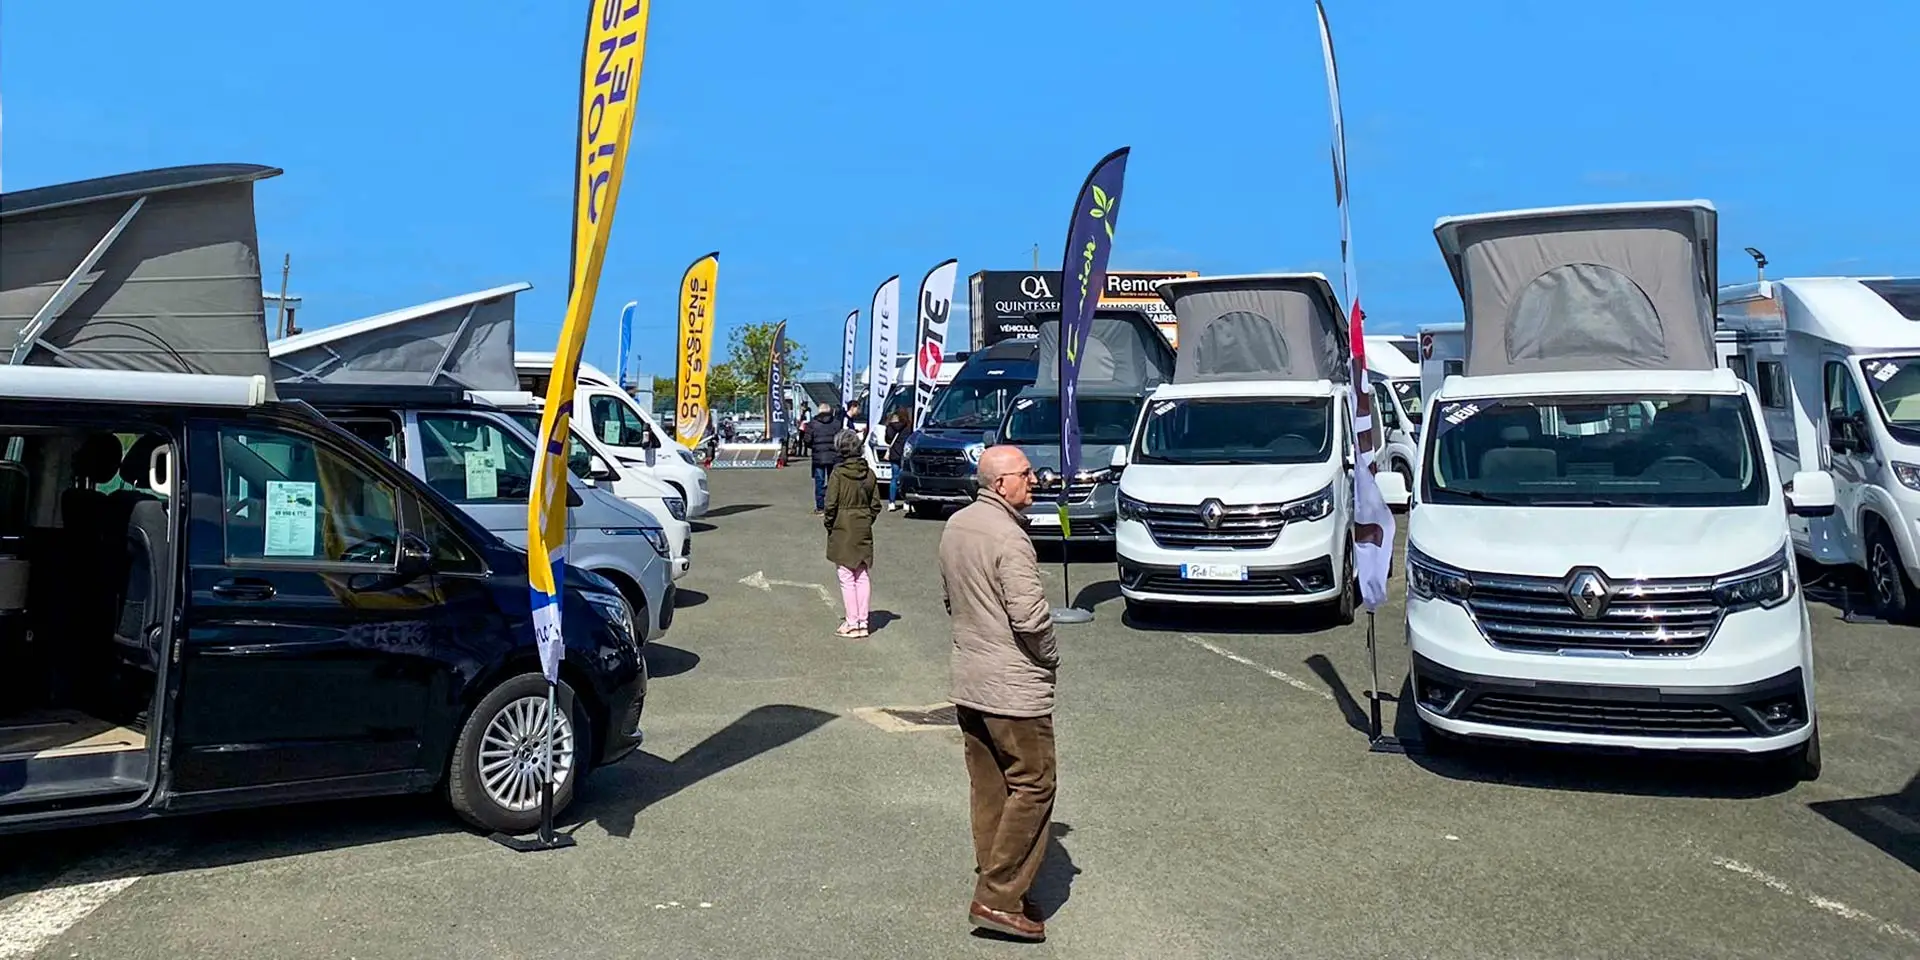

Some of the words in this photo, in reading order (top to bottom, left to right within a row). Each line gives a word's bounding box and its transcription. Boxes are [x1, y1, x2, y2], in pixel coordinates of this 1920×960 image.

[1020, 275, 1054, 299] QA
[995, 301, 1060, 313] QUINTESSE
[692, 279, 708, 373] SOLEIL
[682, 278, 700, 418] OCCASIONS
[877, 309, 890, 400] EURETTE
[690, 383, 702, 418] DU
[1445, 404, 1480, 424] NEUF
